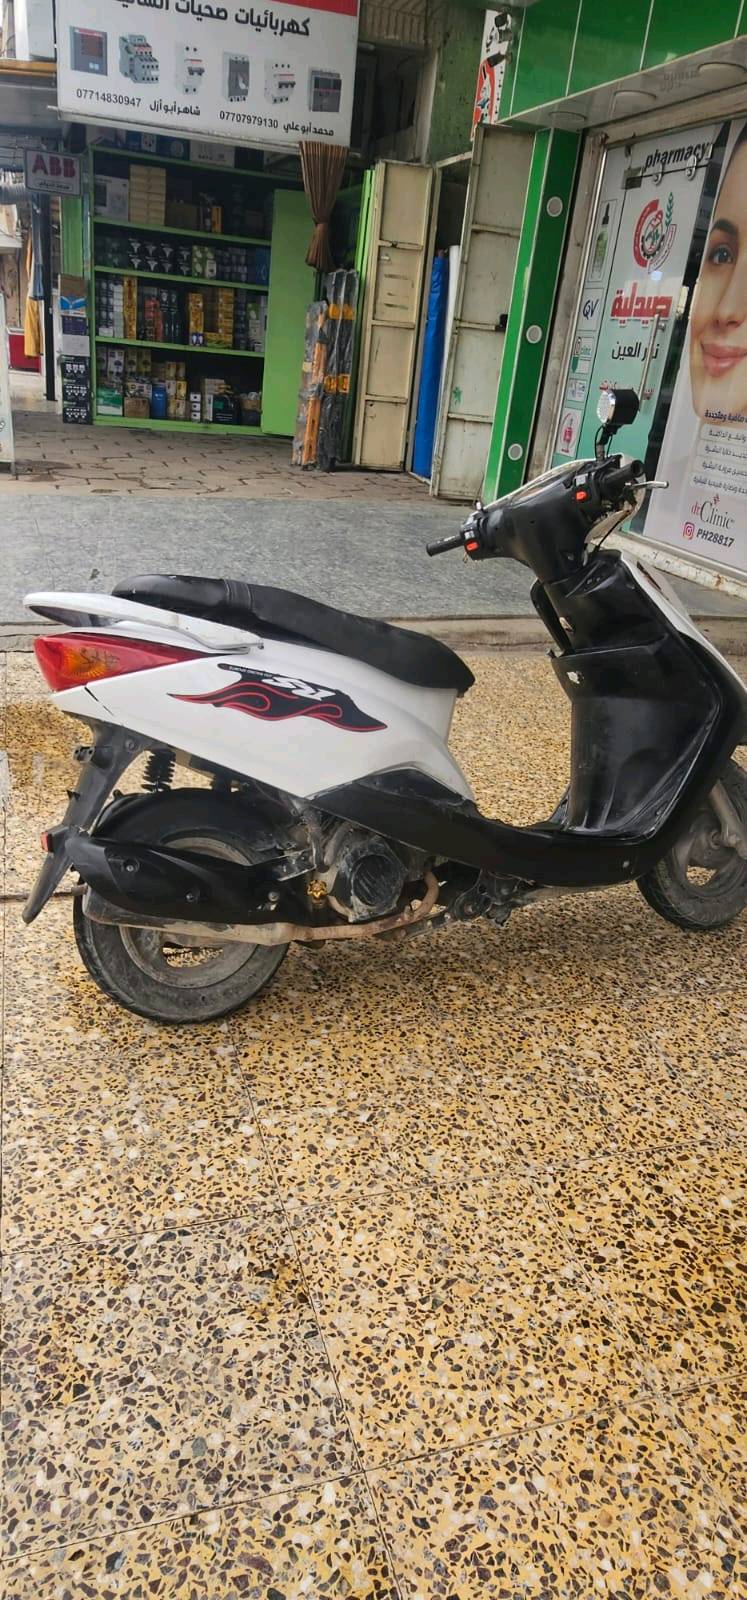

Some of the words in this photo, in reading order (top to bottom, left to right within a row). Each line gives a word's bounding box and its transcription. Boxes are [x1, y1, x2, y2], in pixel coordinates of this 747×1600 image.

[235, 8, 310, 37] كهربائيات
[76, 88, 142, 108] 07714830947
[177, 105, 201, 116] شاهر
[219, 110, 279, 129] 07707979130
[283, 121, 300, 134] علي
[312, 126, 335, 136] محمد
[31, 154, 76, 178] ABB
[643, 142, 710, 173] pharmacy
[583, 299, 599, 320] QV
[610, 281, 673, 325] صيدلية
[611, 341, 641, 360] العين
[641, 343, 660, 361] نر
[696, 528, 735, 549] PH28817
[262, 676, 336, 701] RS
